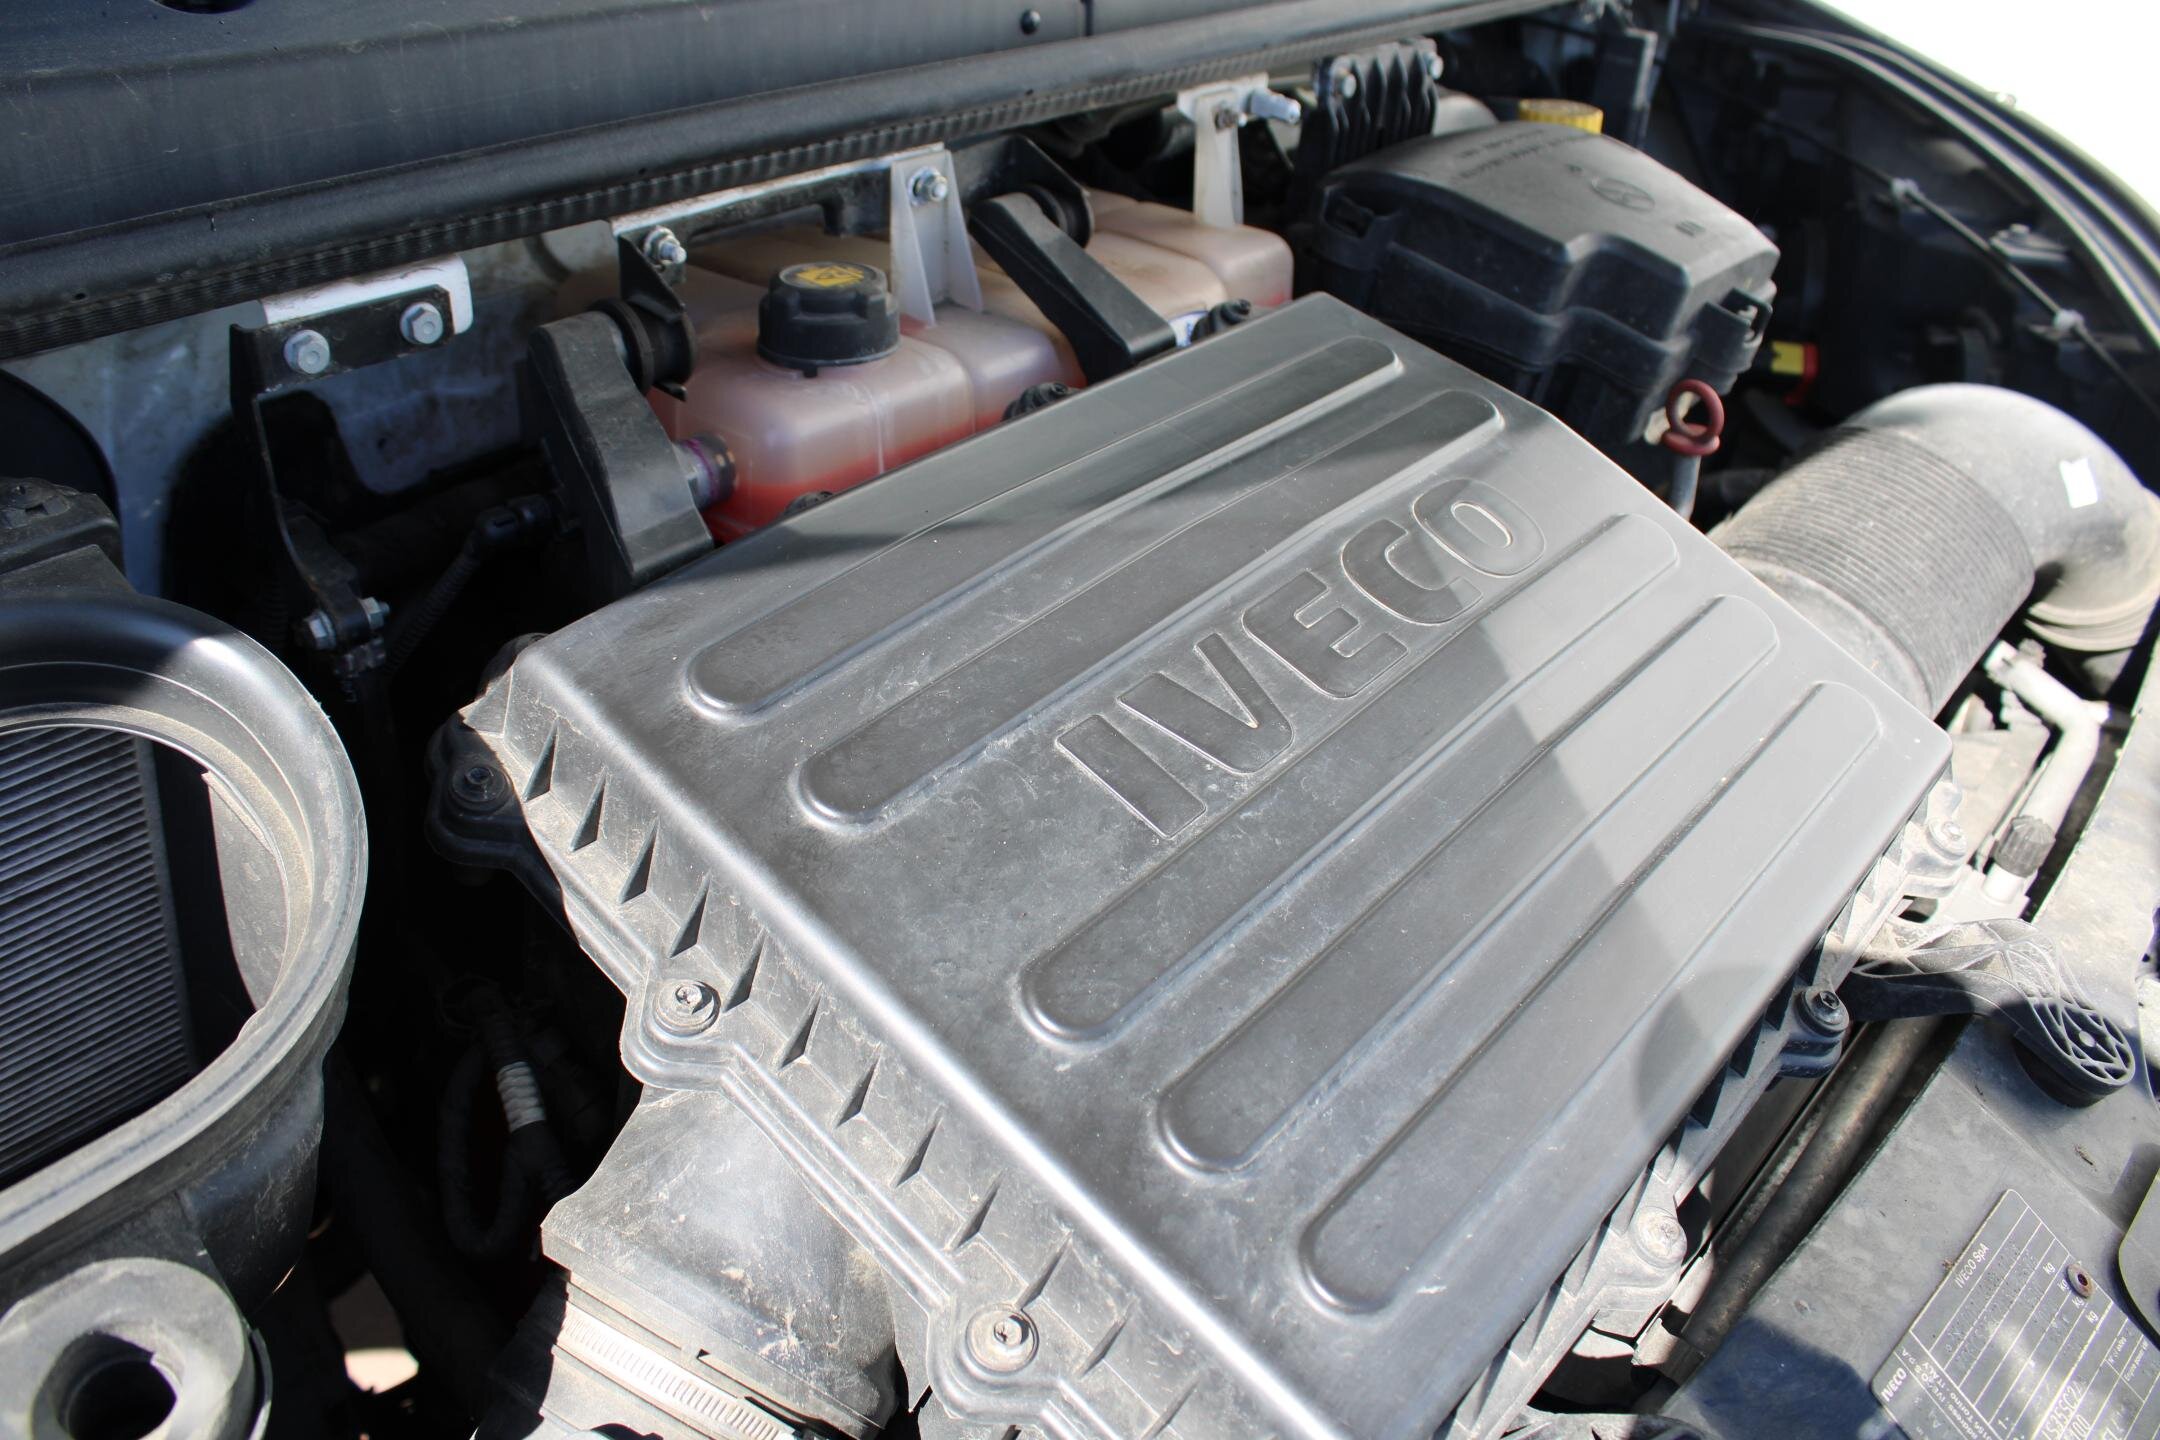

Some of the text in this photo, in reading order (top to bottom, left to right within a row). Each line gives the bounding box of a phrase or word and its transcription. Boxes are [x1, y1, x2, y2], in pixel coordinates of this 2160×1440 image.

[1055, 477, 1546, 840] IVECO
[1954, 1243, 1989, 1288] IVECO SpA
[2043, 1262, 2056, 1275] kg
[2086, 1310, 2099, 1323] kg
[1881, 1367, 1906, 1402] IVECO
[1922, 1362, 1946, 1389] ITALY
[1950, 1392, 1974, 1423] Torino
